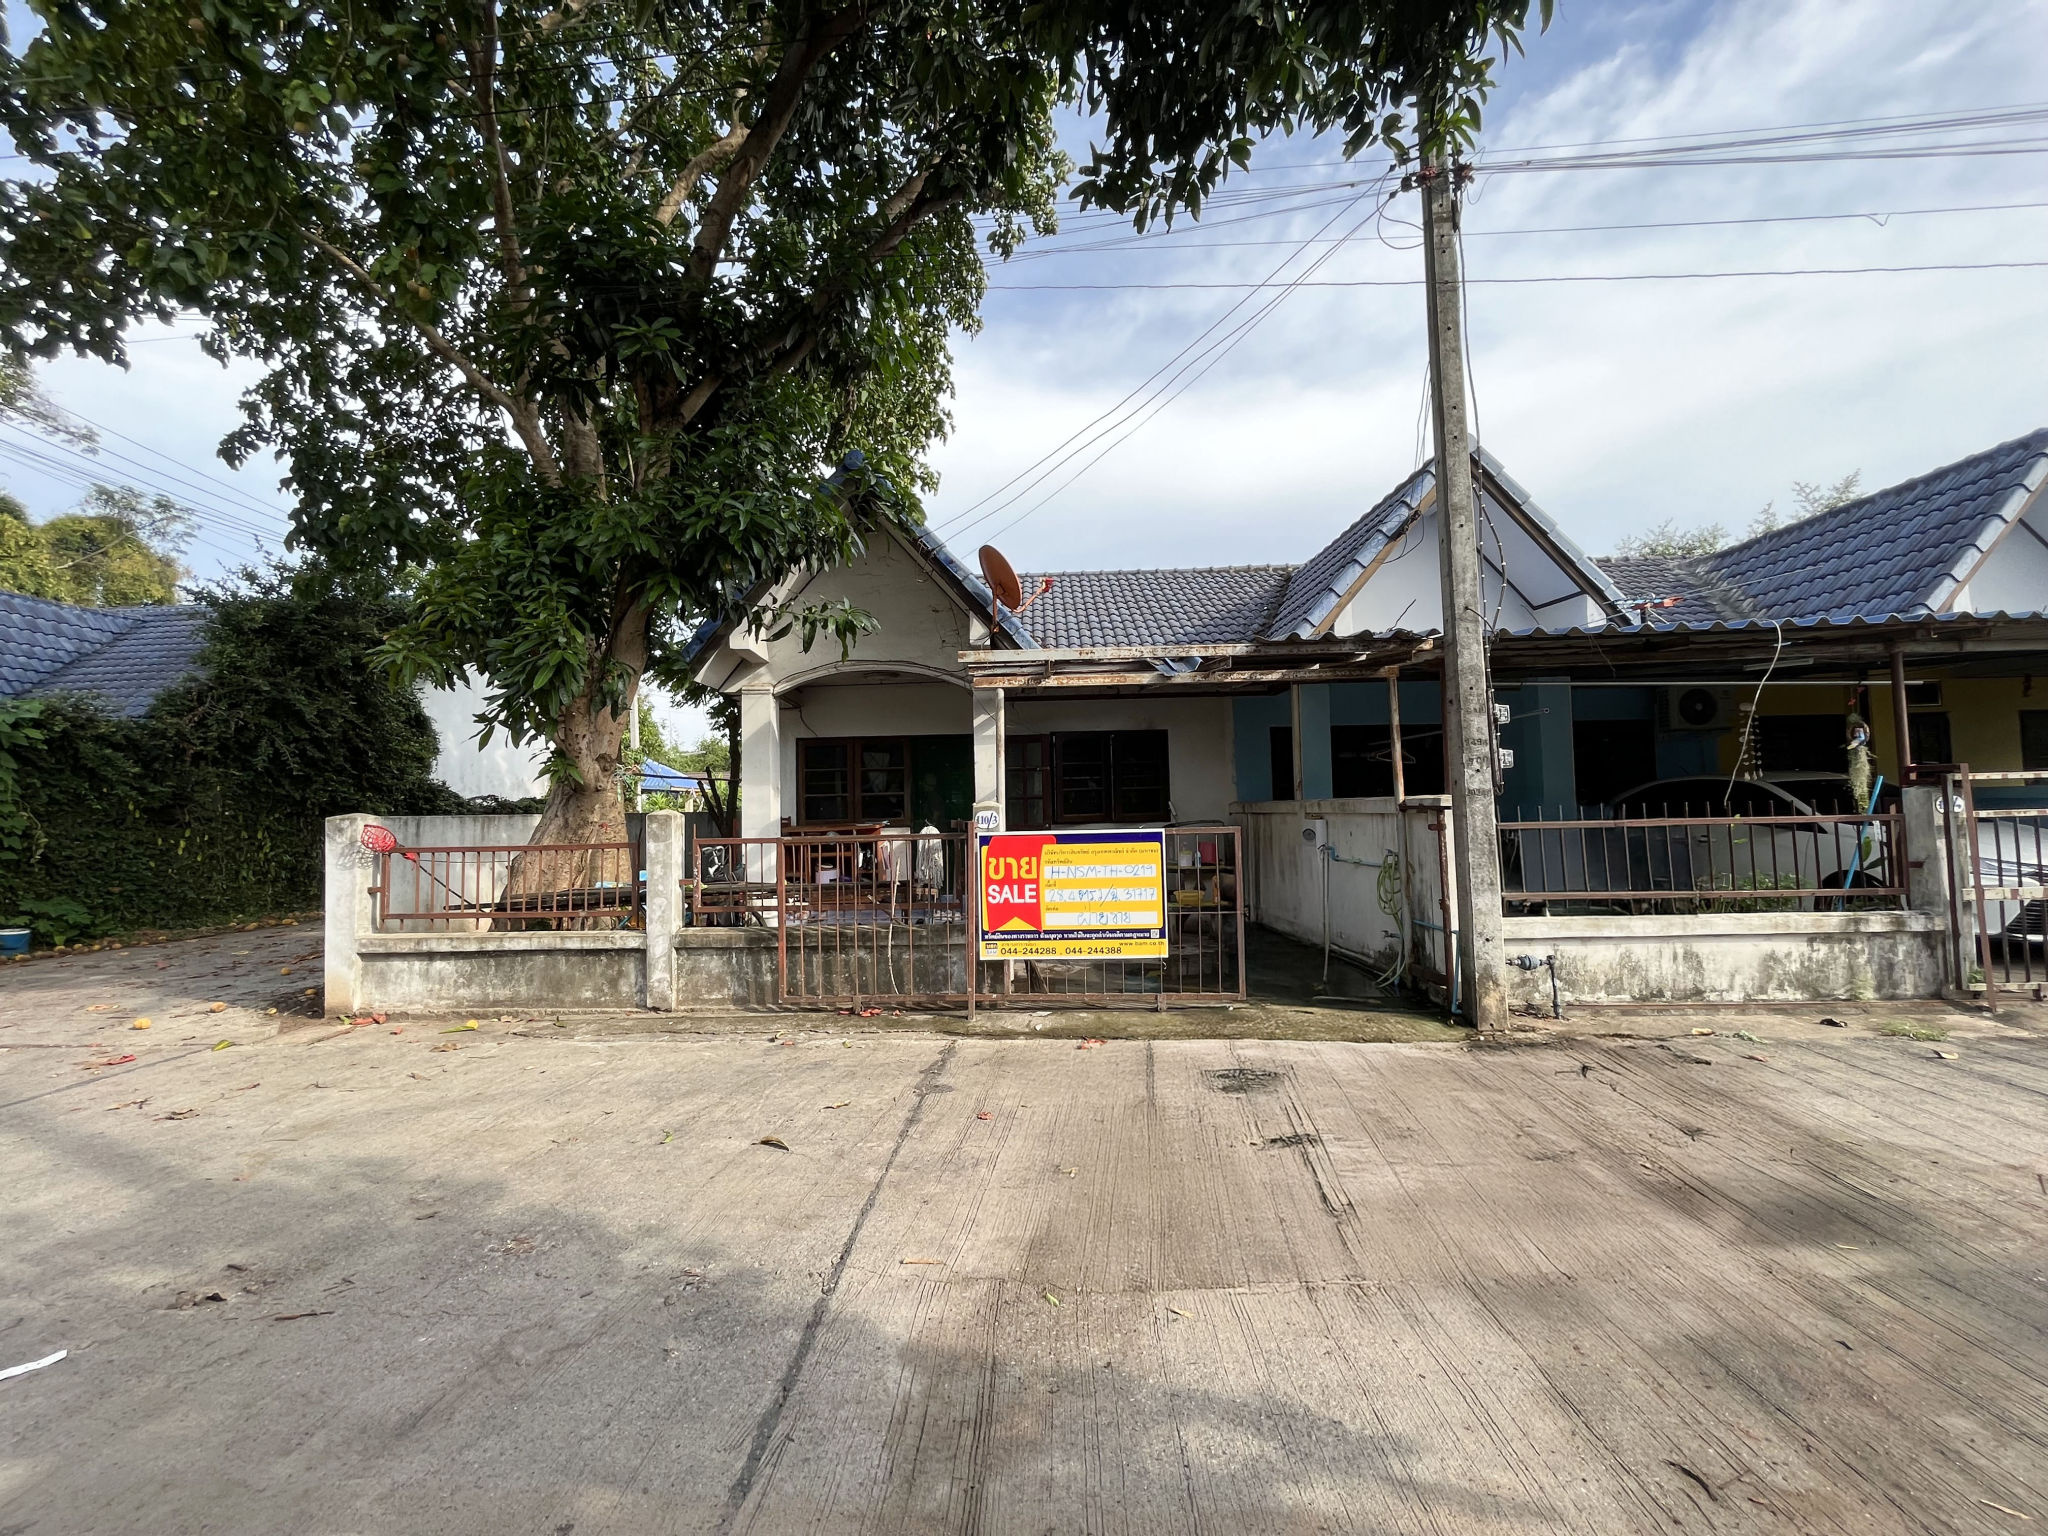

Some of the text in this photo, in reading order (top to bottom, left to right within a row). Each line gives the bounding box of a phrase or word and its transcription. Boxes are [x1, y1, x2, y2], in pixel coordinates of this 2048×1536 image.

[977, 812, 998, 829] 110/3
[988, 856, 1037, 880] ขาย
[988, 884, 1037, 904] SALE
[1000, 946, 1122, 955] 044-244288 044-244388
